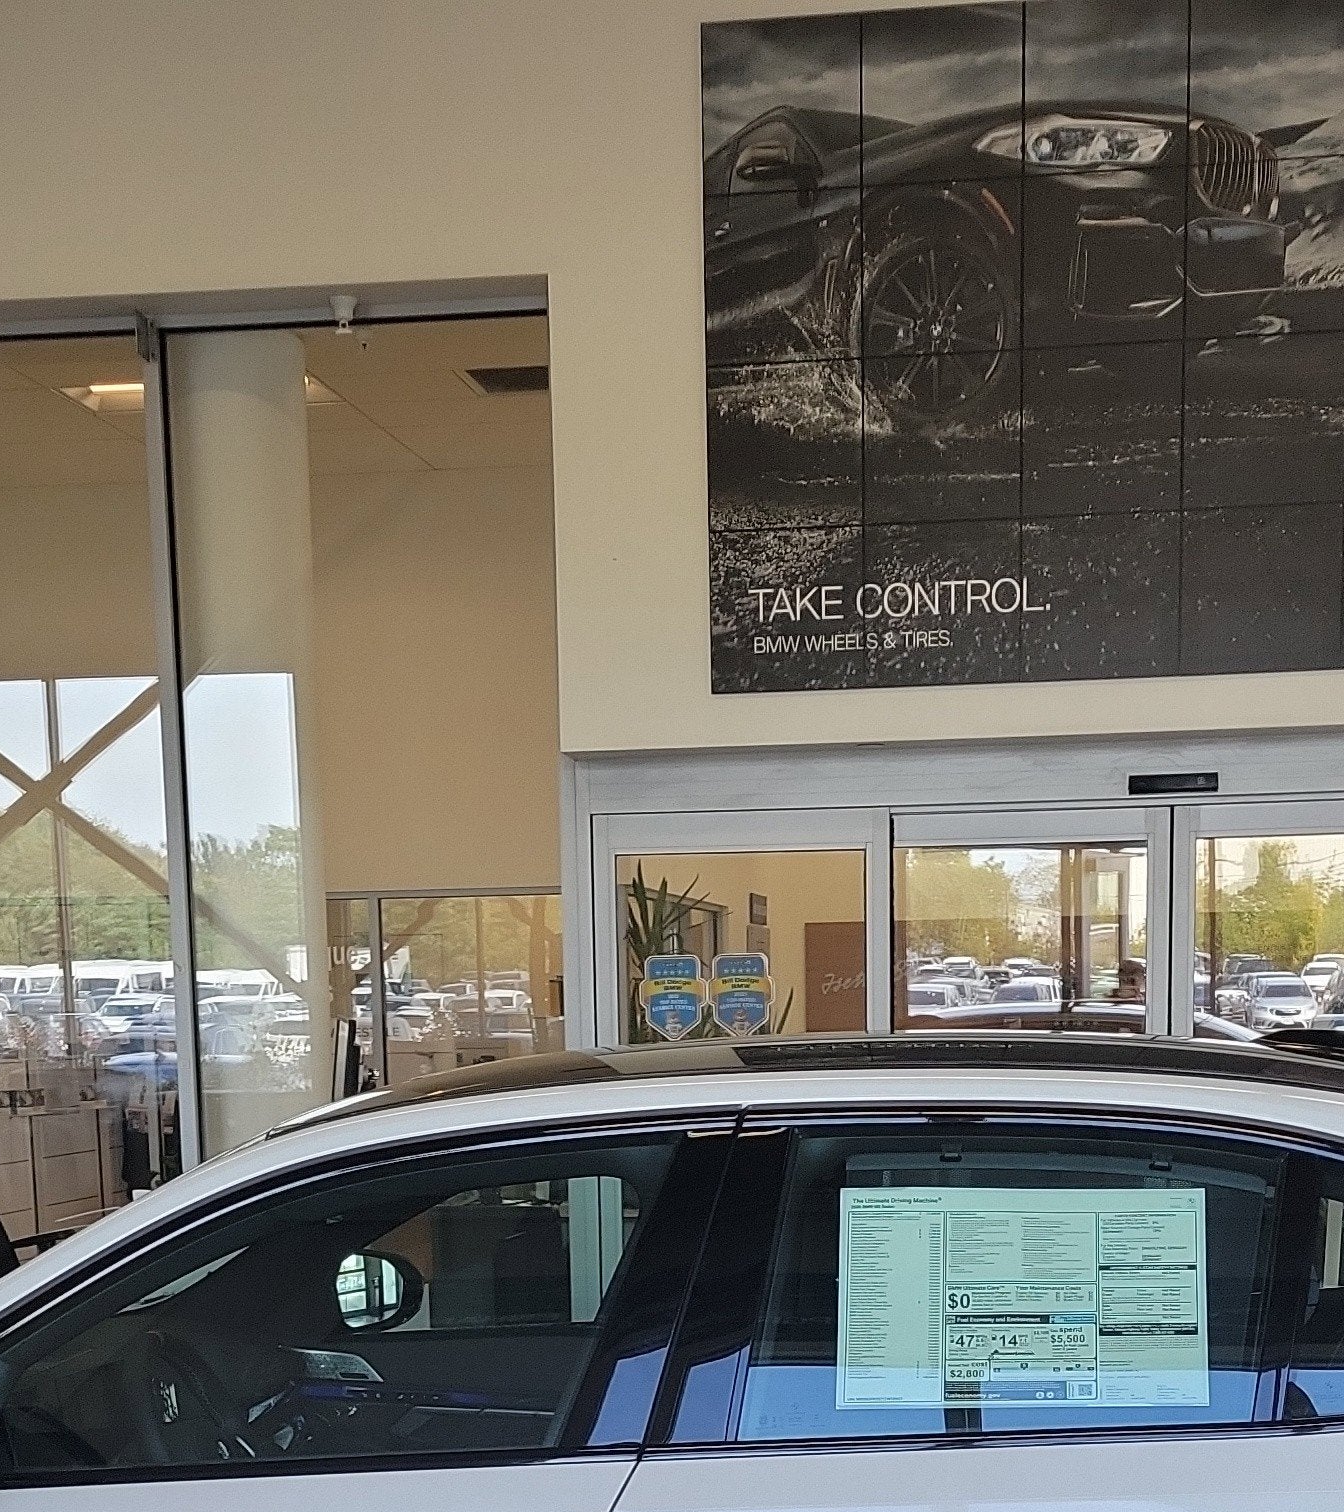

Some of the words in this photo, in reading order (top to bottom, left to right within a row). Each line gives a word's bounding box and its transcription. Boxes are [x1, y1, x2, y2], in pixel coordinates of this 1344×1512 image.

[748, 584, 844, 623] TAKE
[856, 576, 1052, 620] CONTROL.
[753, 635, 800, 654] BMW
[804, 632, 878, 652] WHEELS
[883, 633, 897, 650] &
[947, 1292, 971, 1311] $0
[1059, 1326, 1083, 1334] spend
[955, 1334, 975, 1348] 47
[998, 1334, 1019, 1347] 14
[1050, 1334, 1086, 1346] $5,500
[949, 1369, 985, 1379] $2,800
